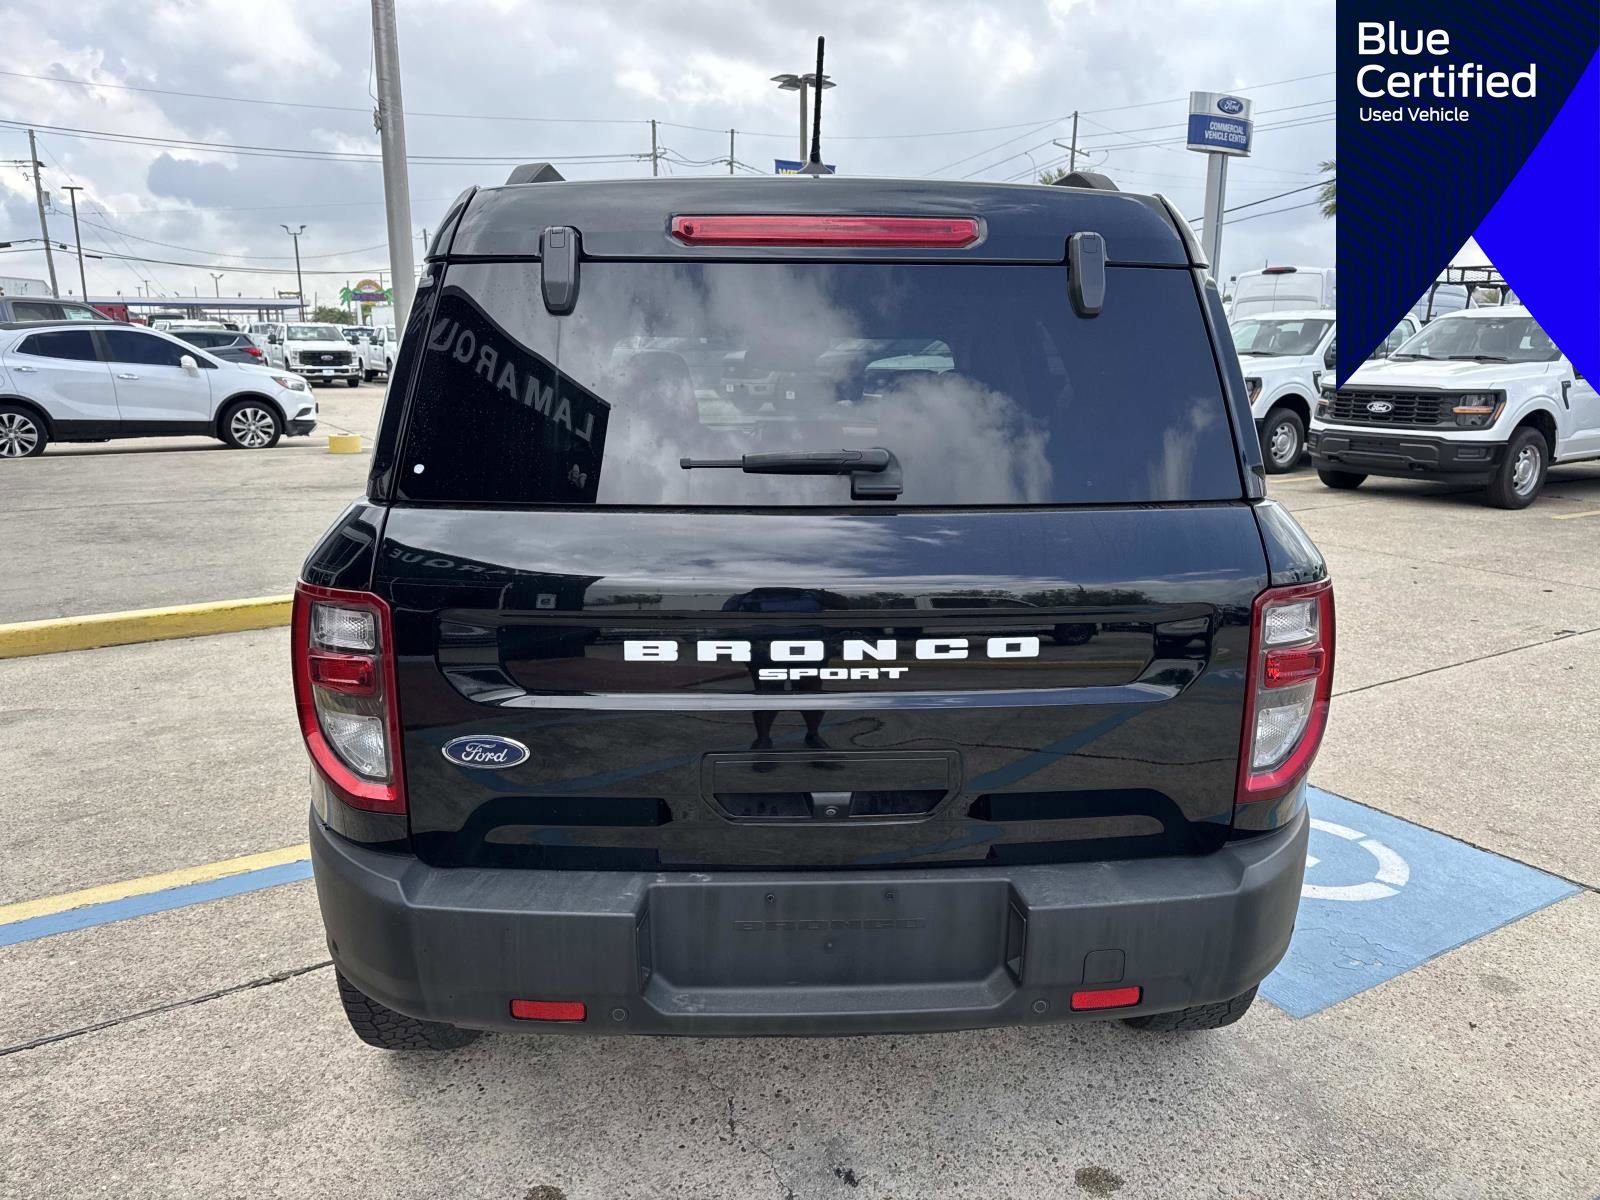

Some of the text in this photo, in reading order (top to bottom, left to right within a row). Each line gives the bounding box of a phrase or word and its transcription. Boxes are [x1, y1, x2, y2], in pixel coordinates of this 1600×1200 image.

[1210, 121, 1244, 134] COMMERCIAL
[1205, 129, 1246, 144] VEHICLE CENTER
[623, 636, 1040, 662] BRONCO
[758, 667, 909, 681] SPORT
[461, 742, 509, 762] Ford
